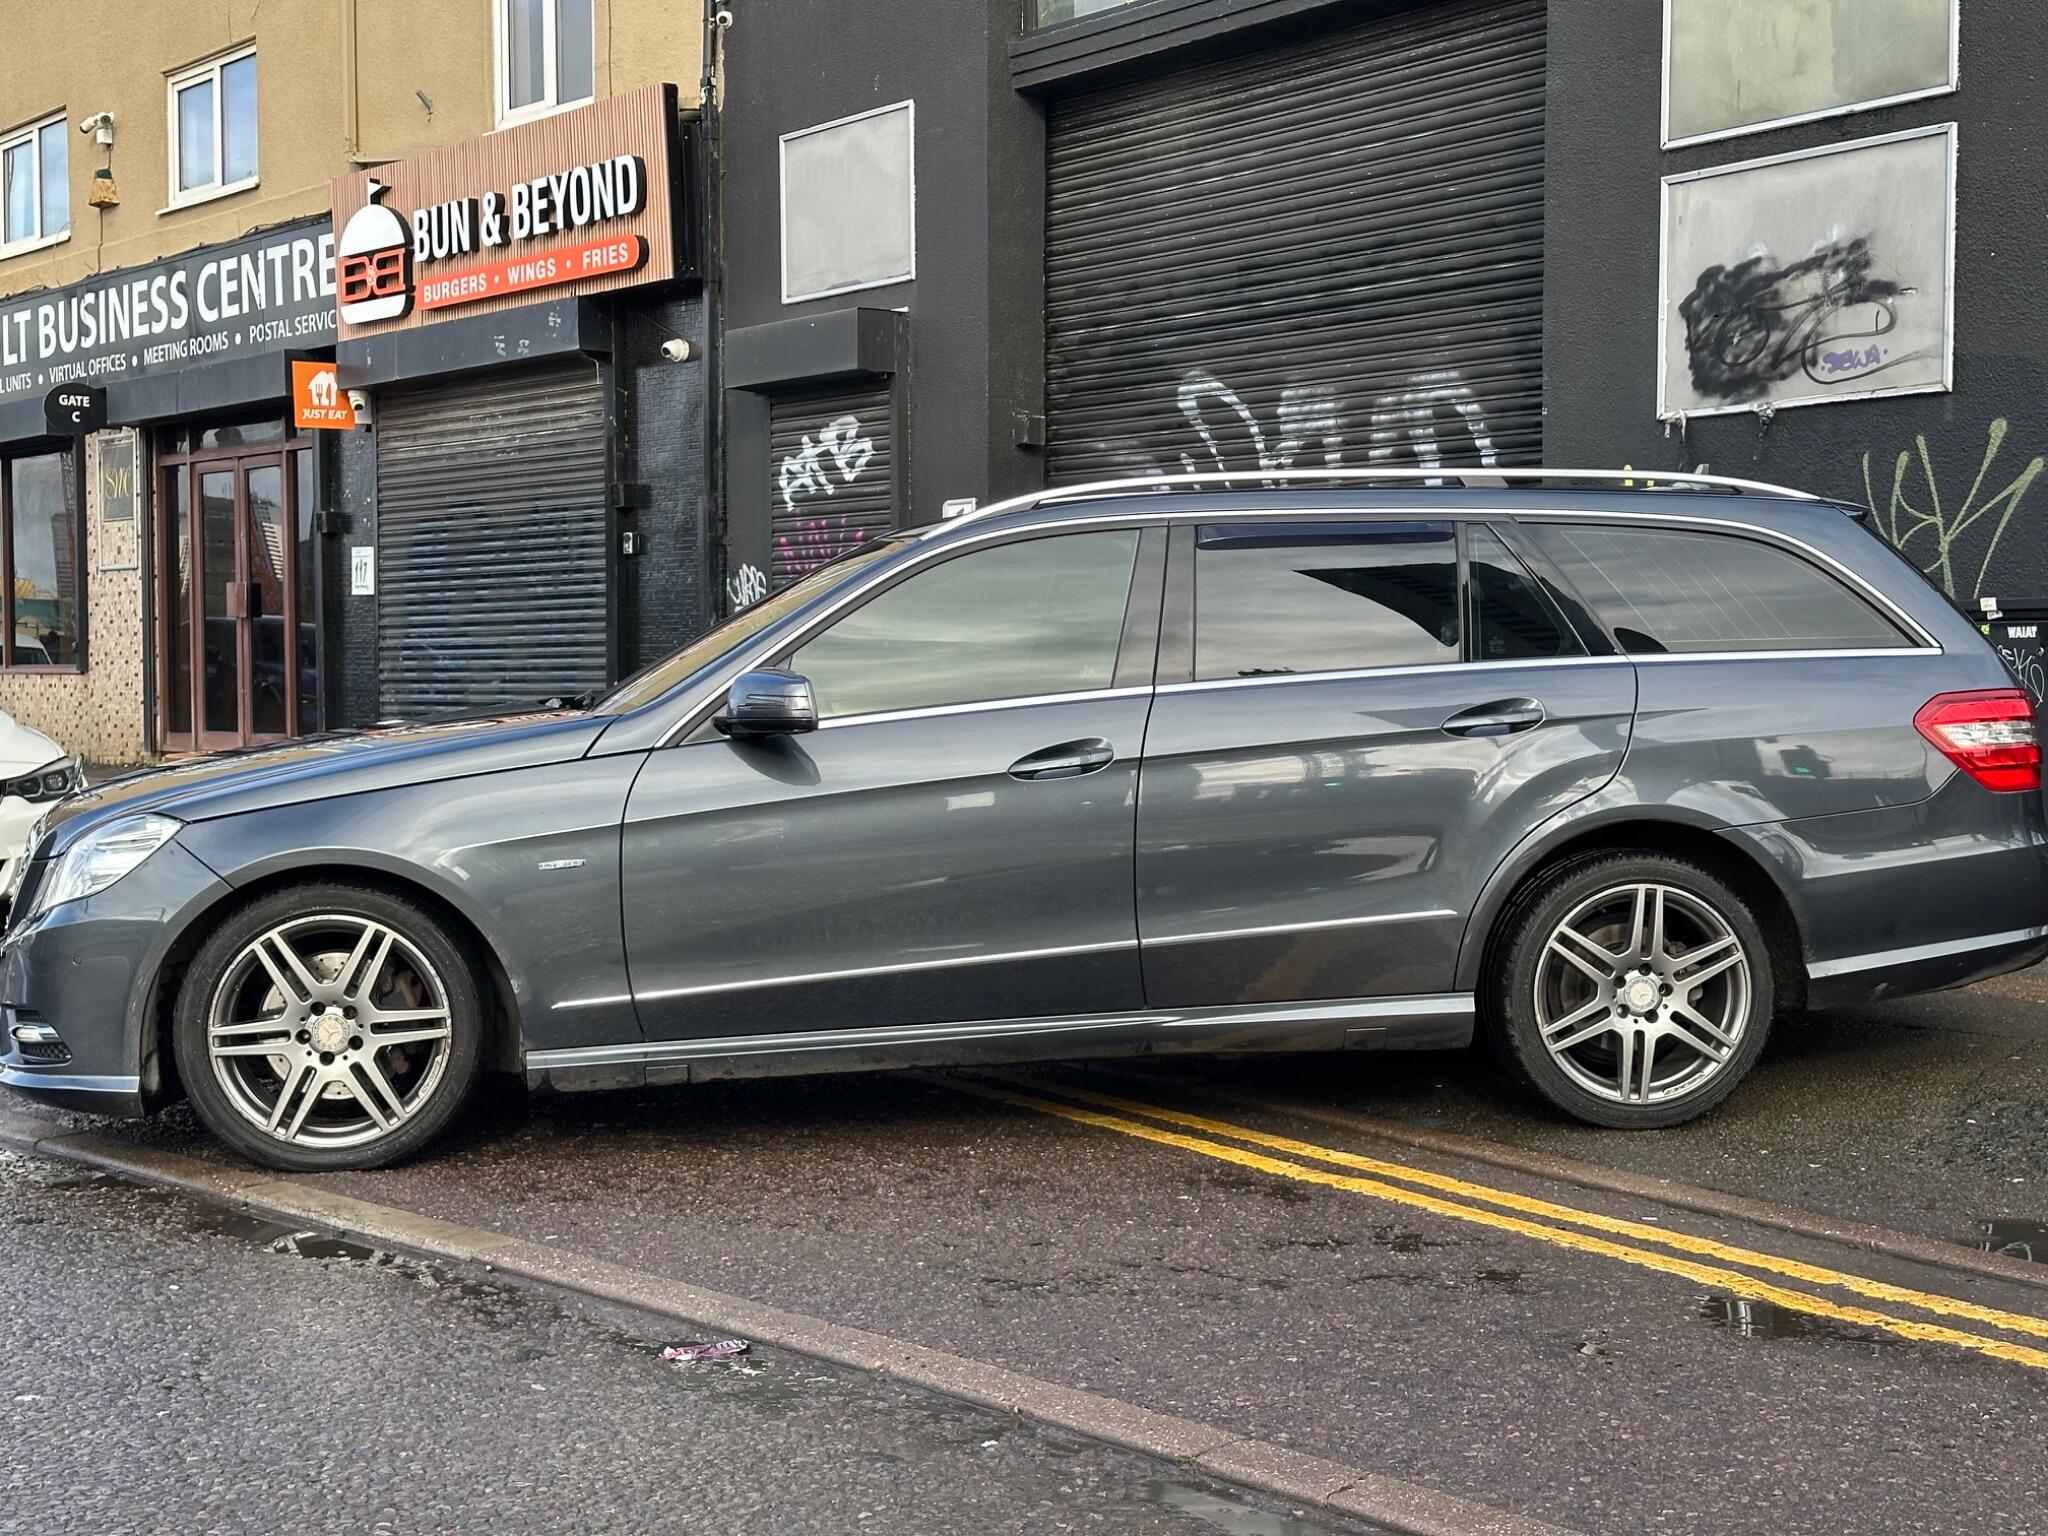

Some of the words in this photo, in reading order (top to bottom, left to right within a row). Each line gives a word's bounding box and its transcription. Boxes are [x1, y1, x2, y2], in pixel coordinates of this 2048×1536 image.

[414, 198, 470, 262] BUN
[481, 191, 502, 247] &
[511, 154, 639, 241] BEYOND
[38, 270, 189, 359] BUSINESS
[196, 232, 337, 322] CENTRE
[423, 272, 488, 304] BURGERS
[507, 257, 557, 286] WINGS
[582, 242, 629, 270] FRIES
[6, 372, 32, 393] UNITS
[49, 361, 87, 384] VIRTUAL
[88, 353, 127, 376] OFFICES
[143, 339, 188, 366] MEETING
[190, 331, 229, 356] ROOMS
[249, 318, 293, 344] POSTAL
[58, 394, 91, 407] GATE
[71, 411, 81, 423] C
[302, 408, 327, 420] JUST
[328, 410, 348, 421] EAT
